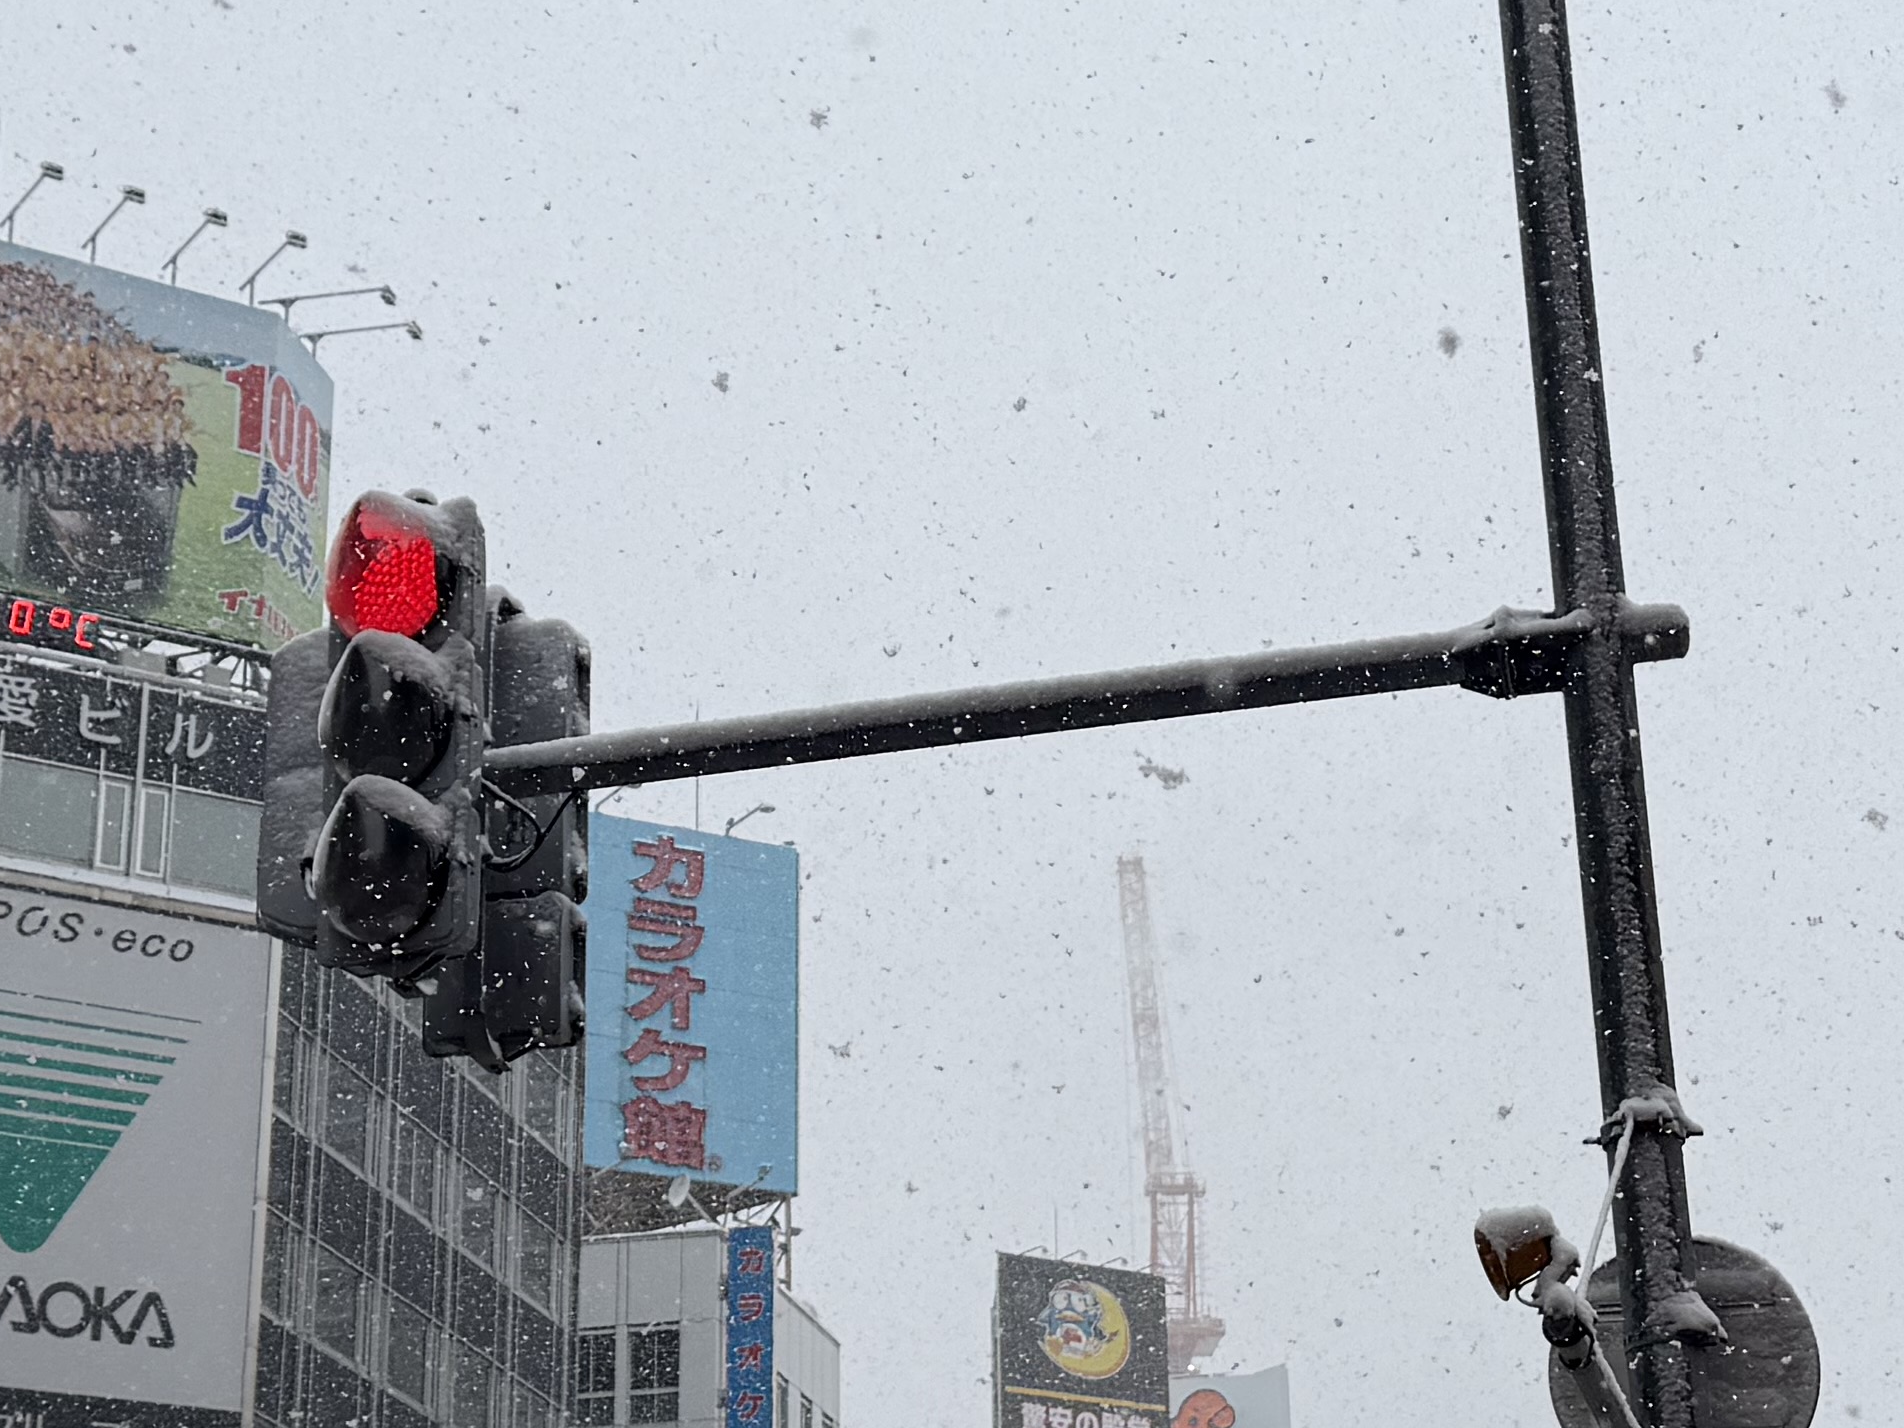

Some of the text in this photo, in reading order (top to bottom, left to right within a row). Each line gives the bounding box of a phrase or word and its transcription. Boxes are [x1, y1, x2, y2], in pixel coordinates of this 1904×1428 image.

[623, 834, 708, 1172] カラオケ館
